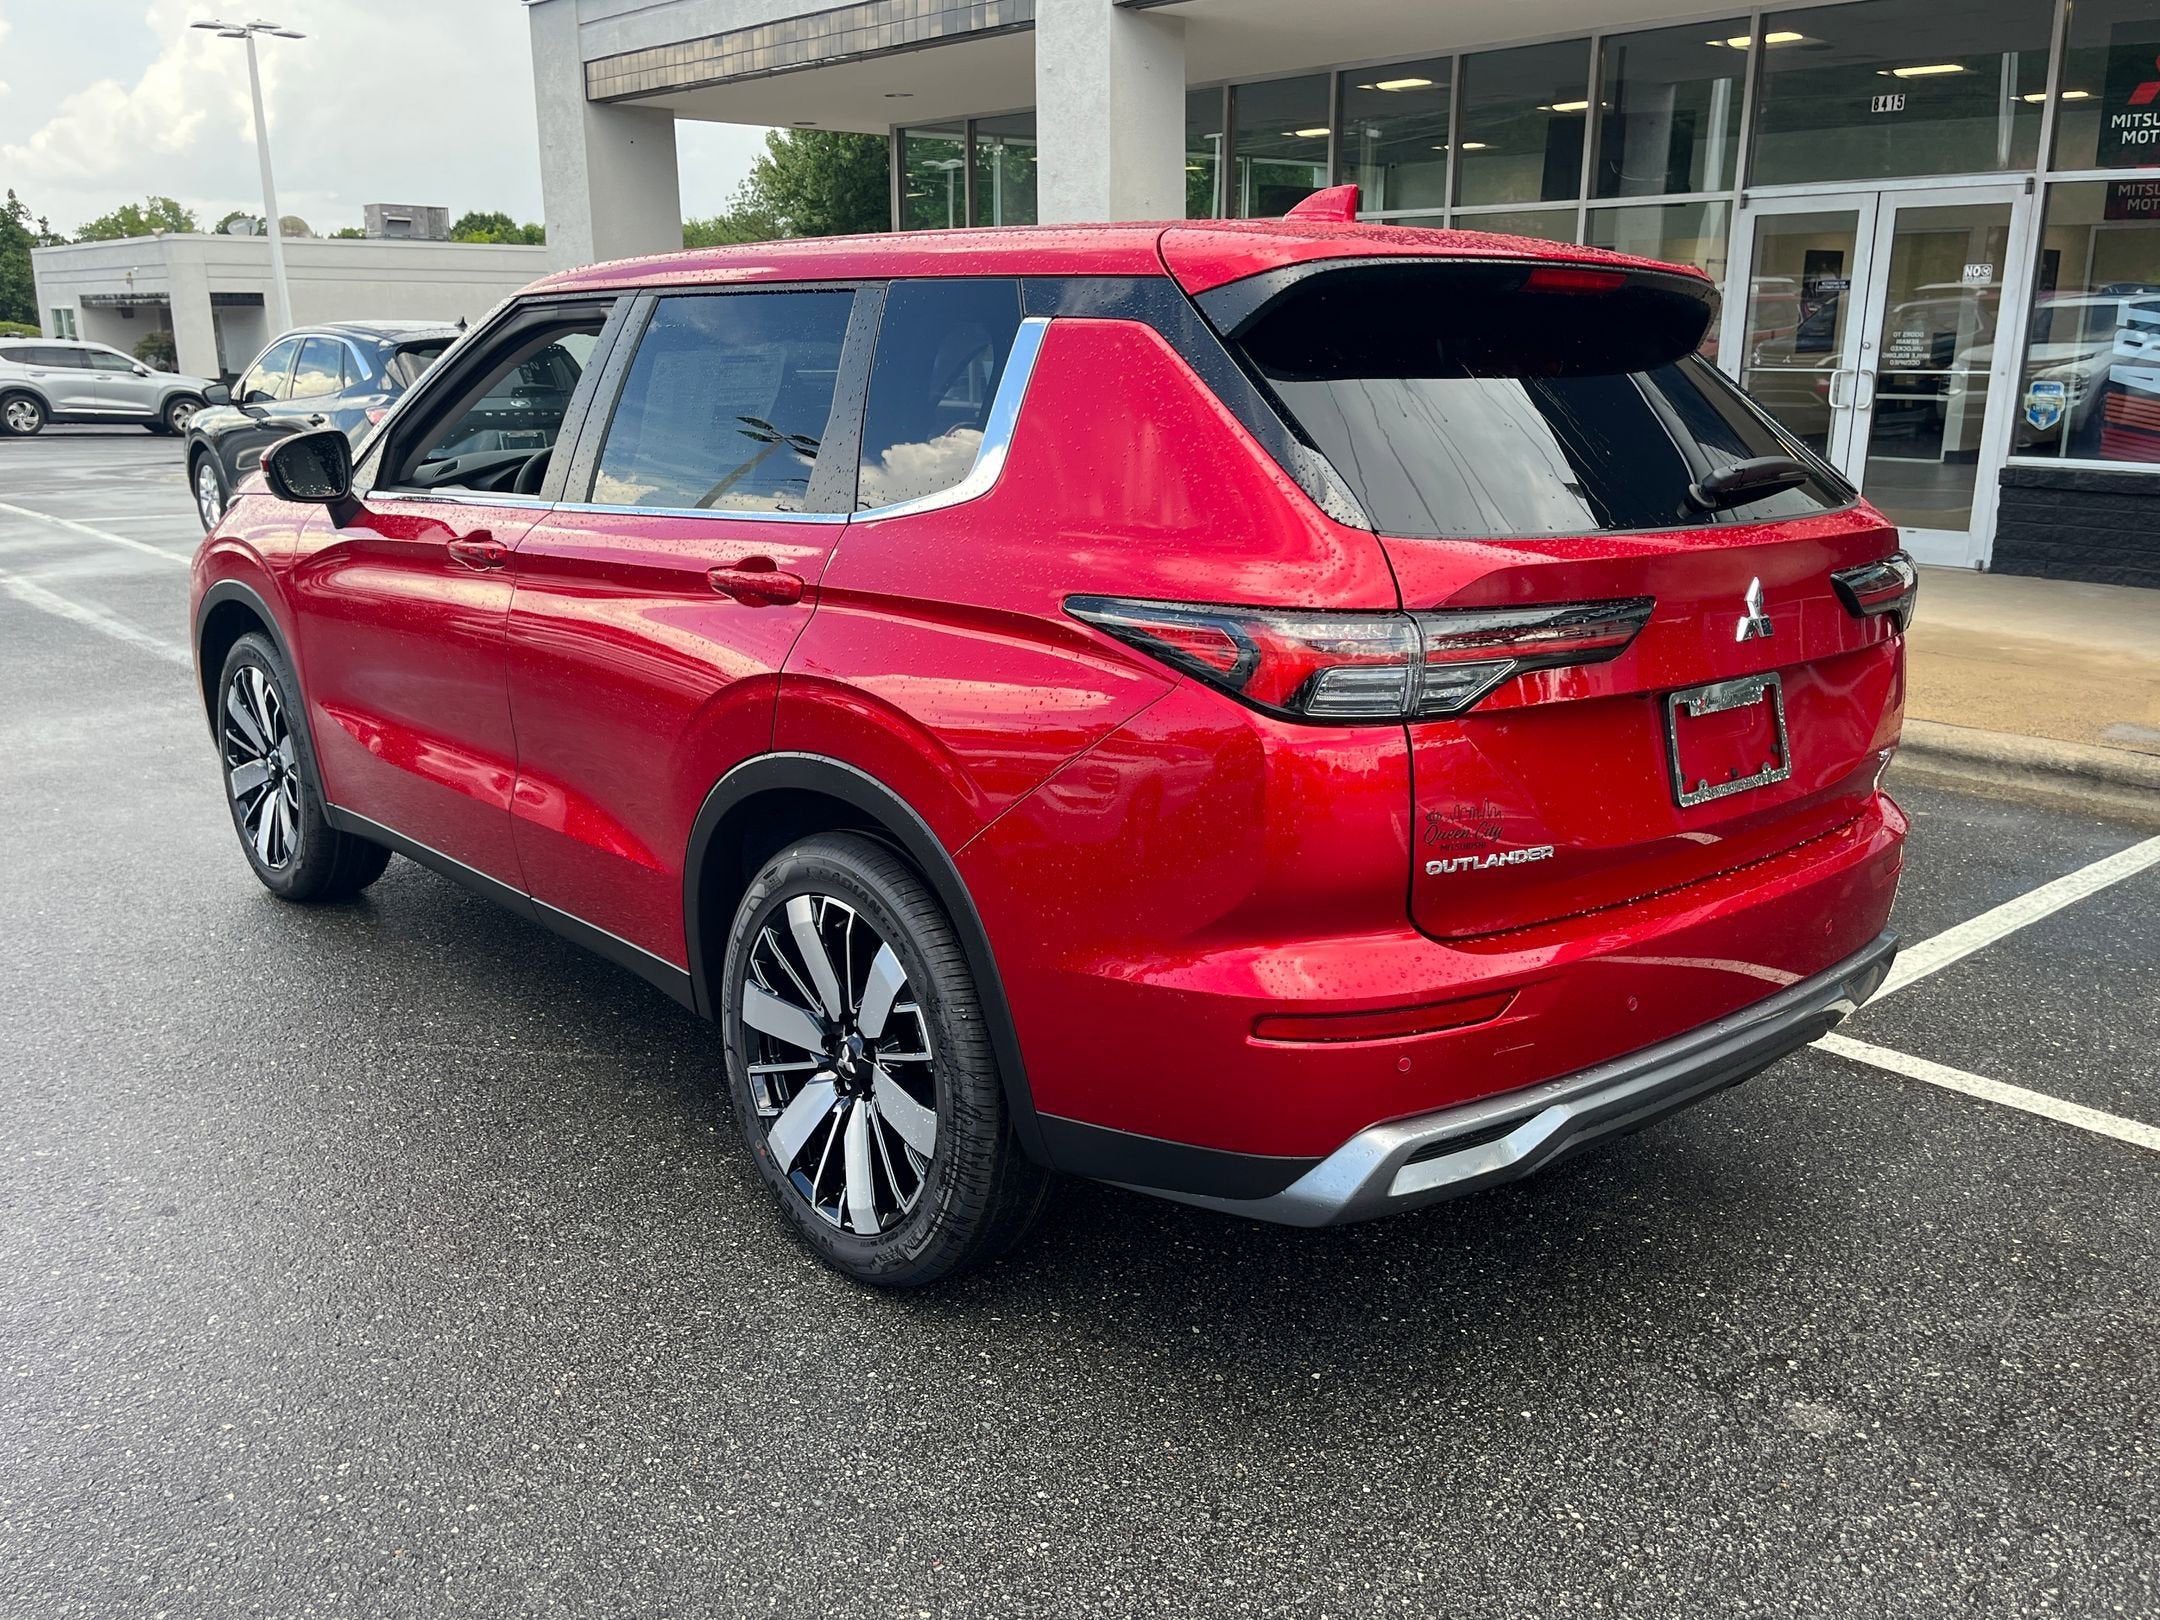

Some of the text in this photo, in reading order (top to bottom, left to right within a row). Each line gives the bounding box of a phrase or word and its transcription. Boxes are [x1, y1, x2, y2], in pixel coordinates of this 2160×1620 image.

[1873, 94, 1904, 111] 8415
[1424, 821, 1504, 846] Queen City
[1425, 845, 1555, 875] OUTLANDER
